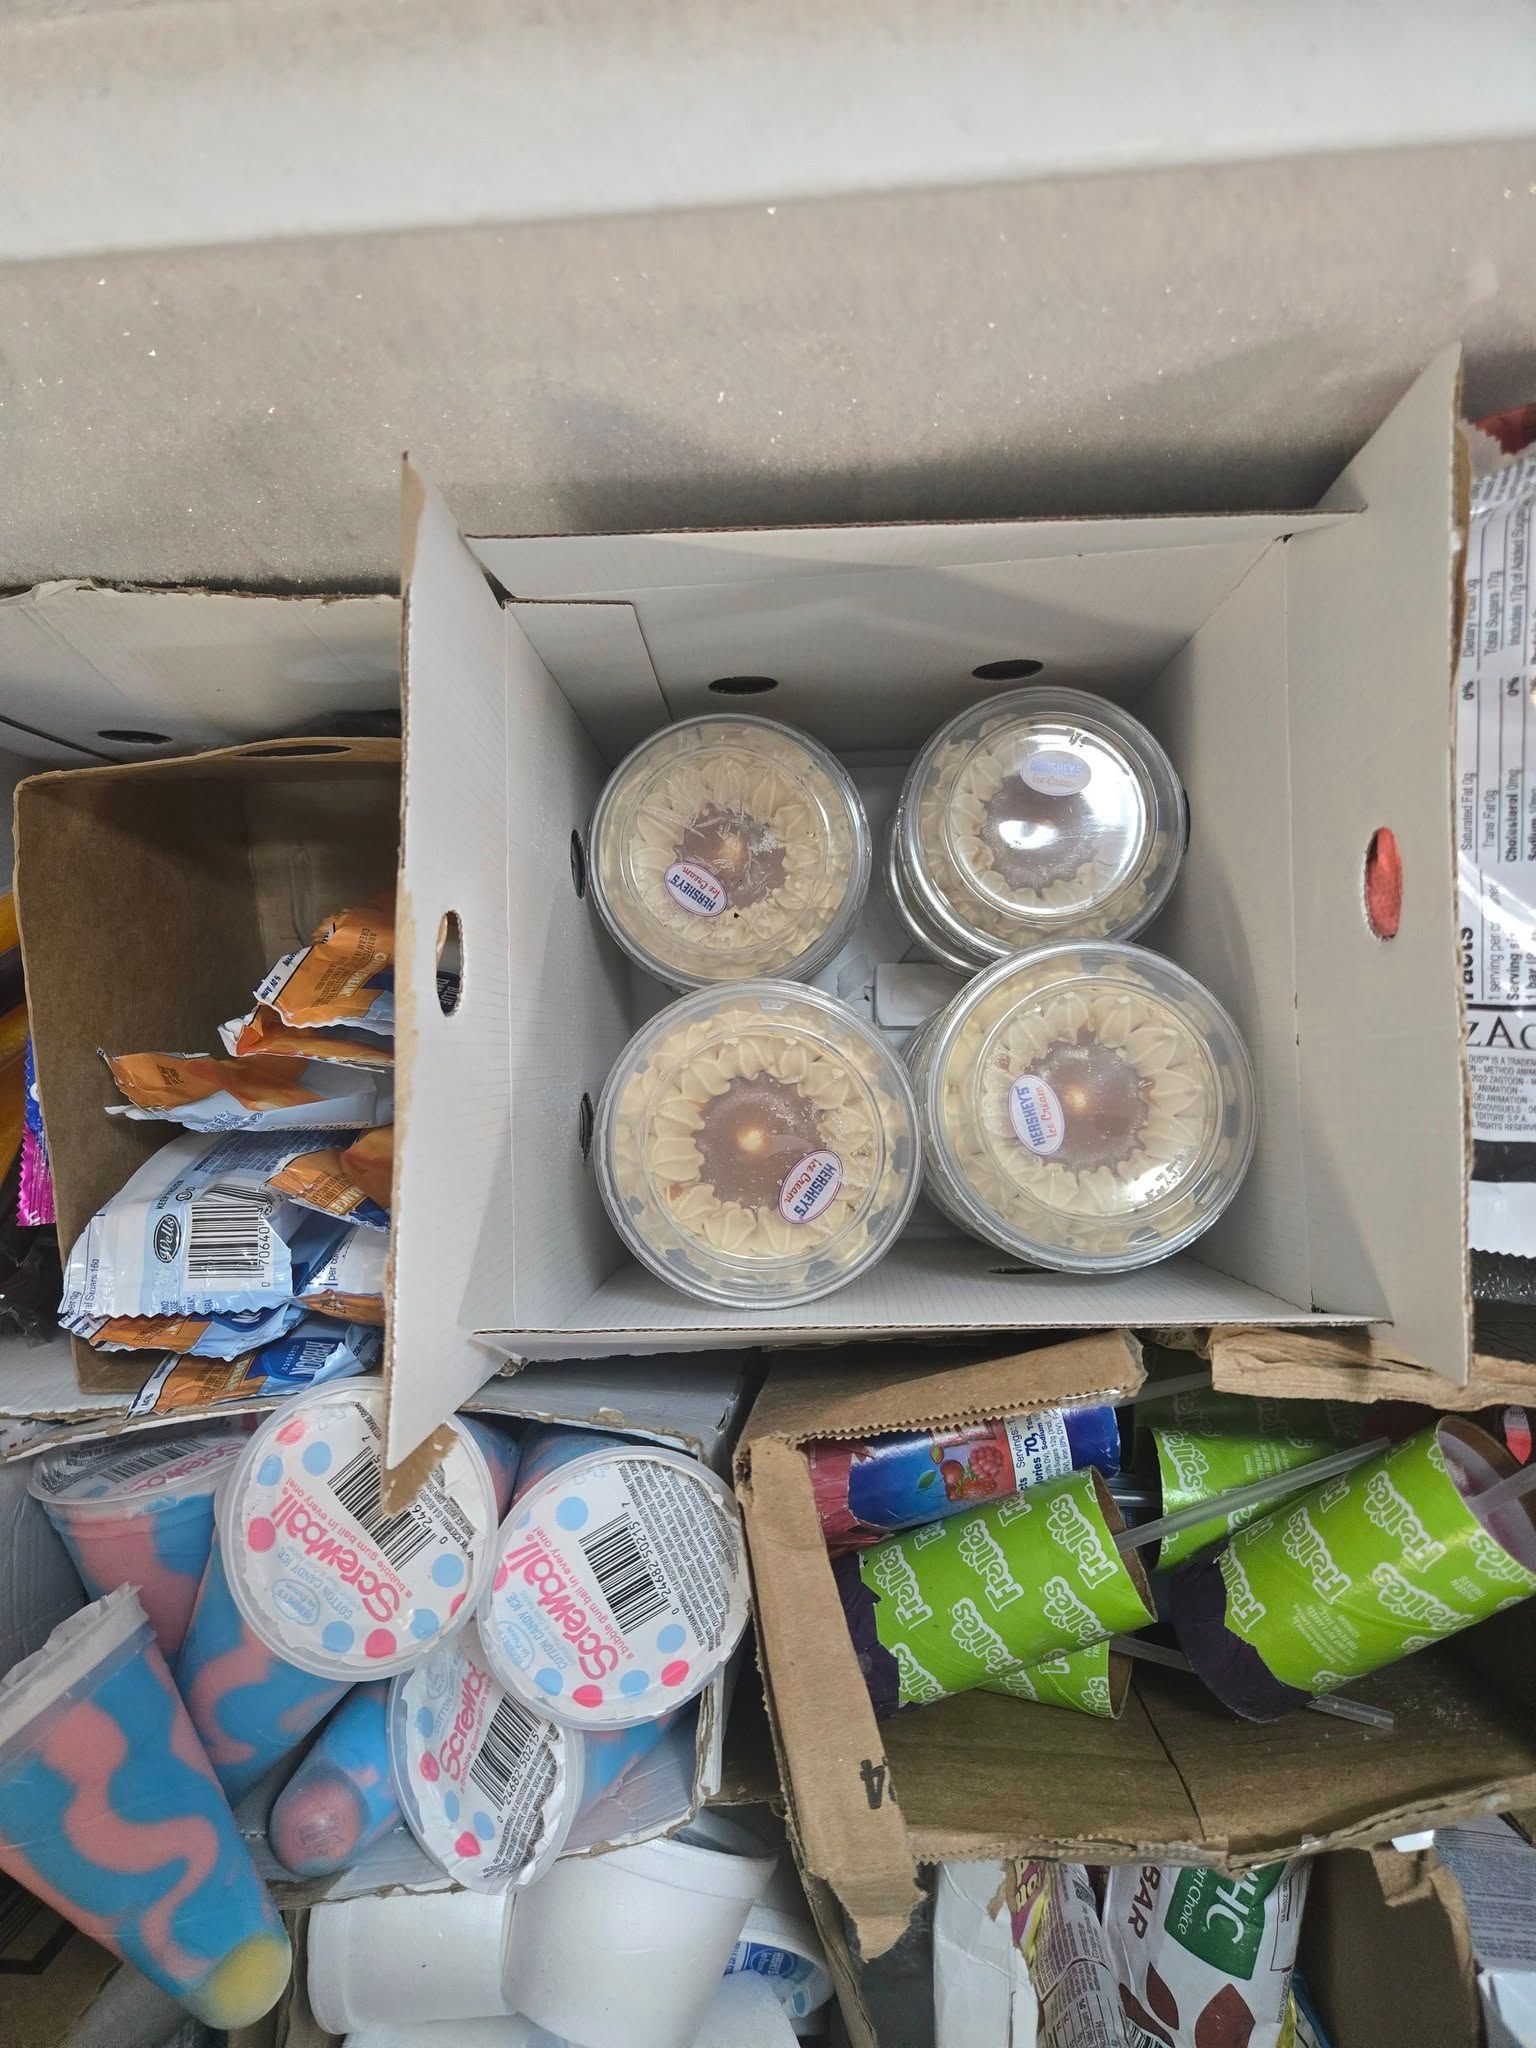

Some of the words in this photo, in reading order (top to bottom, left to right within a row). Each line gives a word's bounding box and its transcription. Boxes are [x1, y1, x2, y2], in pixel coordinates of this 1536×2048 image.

[1509, 539, 1523, 570] Added
[1487, 570, 1503, 588] 17g
[1509, 584, 1525, 601] 17g
[1485, 592, 1501, 628] Sugars
[1463, 680, 1474, 700] 0%
[1462, 772, 1475, 785] 0g
[1506, 769, 1521, 790] 0mg
[1461, 786, 1473, 802] Fat
[1483, 789, 1497, 802] 0g
[1483, 803, 1495, 818] Fat
[1483, 822, 1495, 847] Trans
[1505, 793, 1517, 862] Cholesterol
[669, 872, 716, 912] HERSHEY'S
[1487, 934, 1503, 951] per
[1487, 953, 1503, 992] serving
[1506, 953, 1521, 1000] Serving
[1014, 1085, 1045, 1146] HERSHEY'S
[1036, 1085, 1051, 1120] Cream
[1046, 1122, 1056, 1138] Ice
[806, 1158, 822, 1172] Ice
[784, 1172, 811, 1202] Cream
[793, 1163, 836, 1216] HERSHEY'S
[157, 1216, 177, 1260] Wells
[253, 1225, 275, 1267] 70640
[288, 1340, 336, 1376] RIBBON
[360, 1433, 371, 1442] 7
[1010, 1426, 1025, 1467] Servings:
[1024, 1432, 1038, 1456] 70,
[1037, 1422, 1047, 1450] Sodium
[302, 1494, 330, 1521] every
[620, 1499, 630, 1507] 7
[325, 1516, 339, 1530] in
[336, 1524, 357, 1545] ball
[1363, 1469, 1447, 1574] Frollies
[353, 1538, 379, 1563] gum
[437, 1534, 449, 1545] 0
[531, 1525, 553, 1549] one!
[628, 1519, 654, 1558] 50215
[652, 1539, 666, 1555] MARK
[1047, 1493, 1119, 1590] Frollies
[268, 1498, 400, 1623] Screwball
[273, 1546, 294, 1567] ICE
[547, 1545, 573, 1576] every
[658, 1553, 678, 1582] REGISTERED
[958, 1518, 1025, 1612] Frollies
[1282, 1505, 1352, 1605] Frollies
[290, 1558, 324, 1592] CANDY
[373, 1559, 407, 1592] bubble
[566, 1574, 580, 1588] in
[646, 1559, 672, 1597] 24682
[873, 1544, 934, 1630] Frollies
[316, 1584, 355, 1621] COTTON
[403, 1588, 414, 1598] a
[504, 1591, 523, 1612] ICE
[573, 1585, 592, 1605] ball
[506, 1542, 620, 1681] Screwball
[518, 1609, 545, 1641] CANDY
[586, 1600, 608, 1625] gum
[670, 1606, 680, 1615] 0
[601, 1622, 629, 1655] bubble
[538, 1637, 568, 1671] COTTON
[624, 1651, 634, 1661] a
[495, 1814, 505, 1823] 0
[501, 1768, 524, 1806] 24682
[519, 1729, 541, 1766] 50215
[1128, 1865, 1160, 1939] BAR
[1177, 1884, 1202, 1936] Choice
